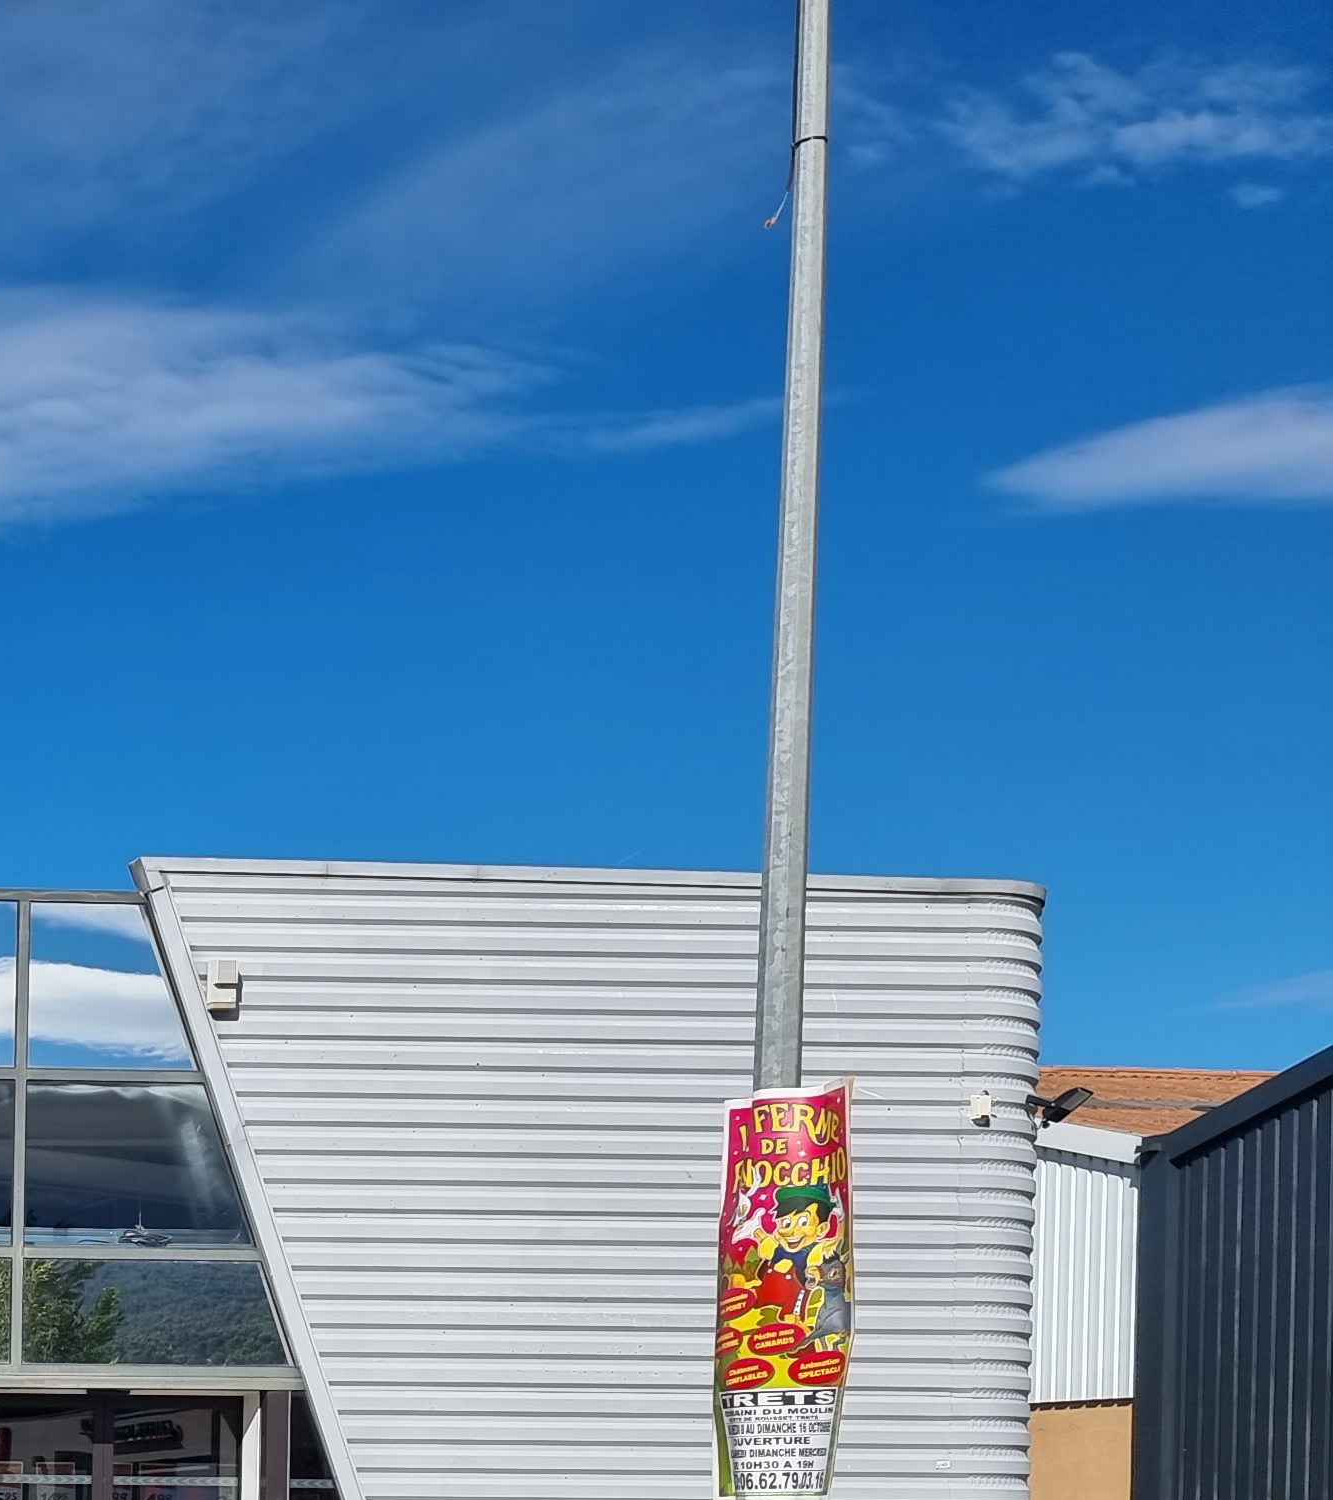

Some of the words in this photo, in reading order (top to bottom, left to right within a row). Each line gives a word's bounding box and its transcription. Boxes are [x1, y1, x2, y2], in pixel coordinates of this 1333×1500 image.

[761, 1138, 788, 1155] DE
[721, 1390, 835, 1408] TRETS
[762, 1408, 783, 1416] DU
[787, 1406, 834, 1415] MOULIN
[757, 1422, 797, 1434] DIMANCHE
[749, 1447, 797, 1458] DIMANCHE
[740, 1460, 780, 1470] 10H30
[783, 1460, 793, 1469] A
